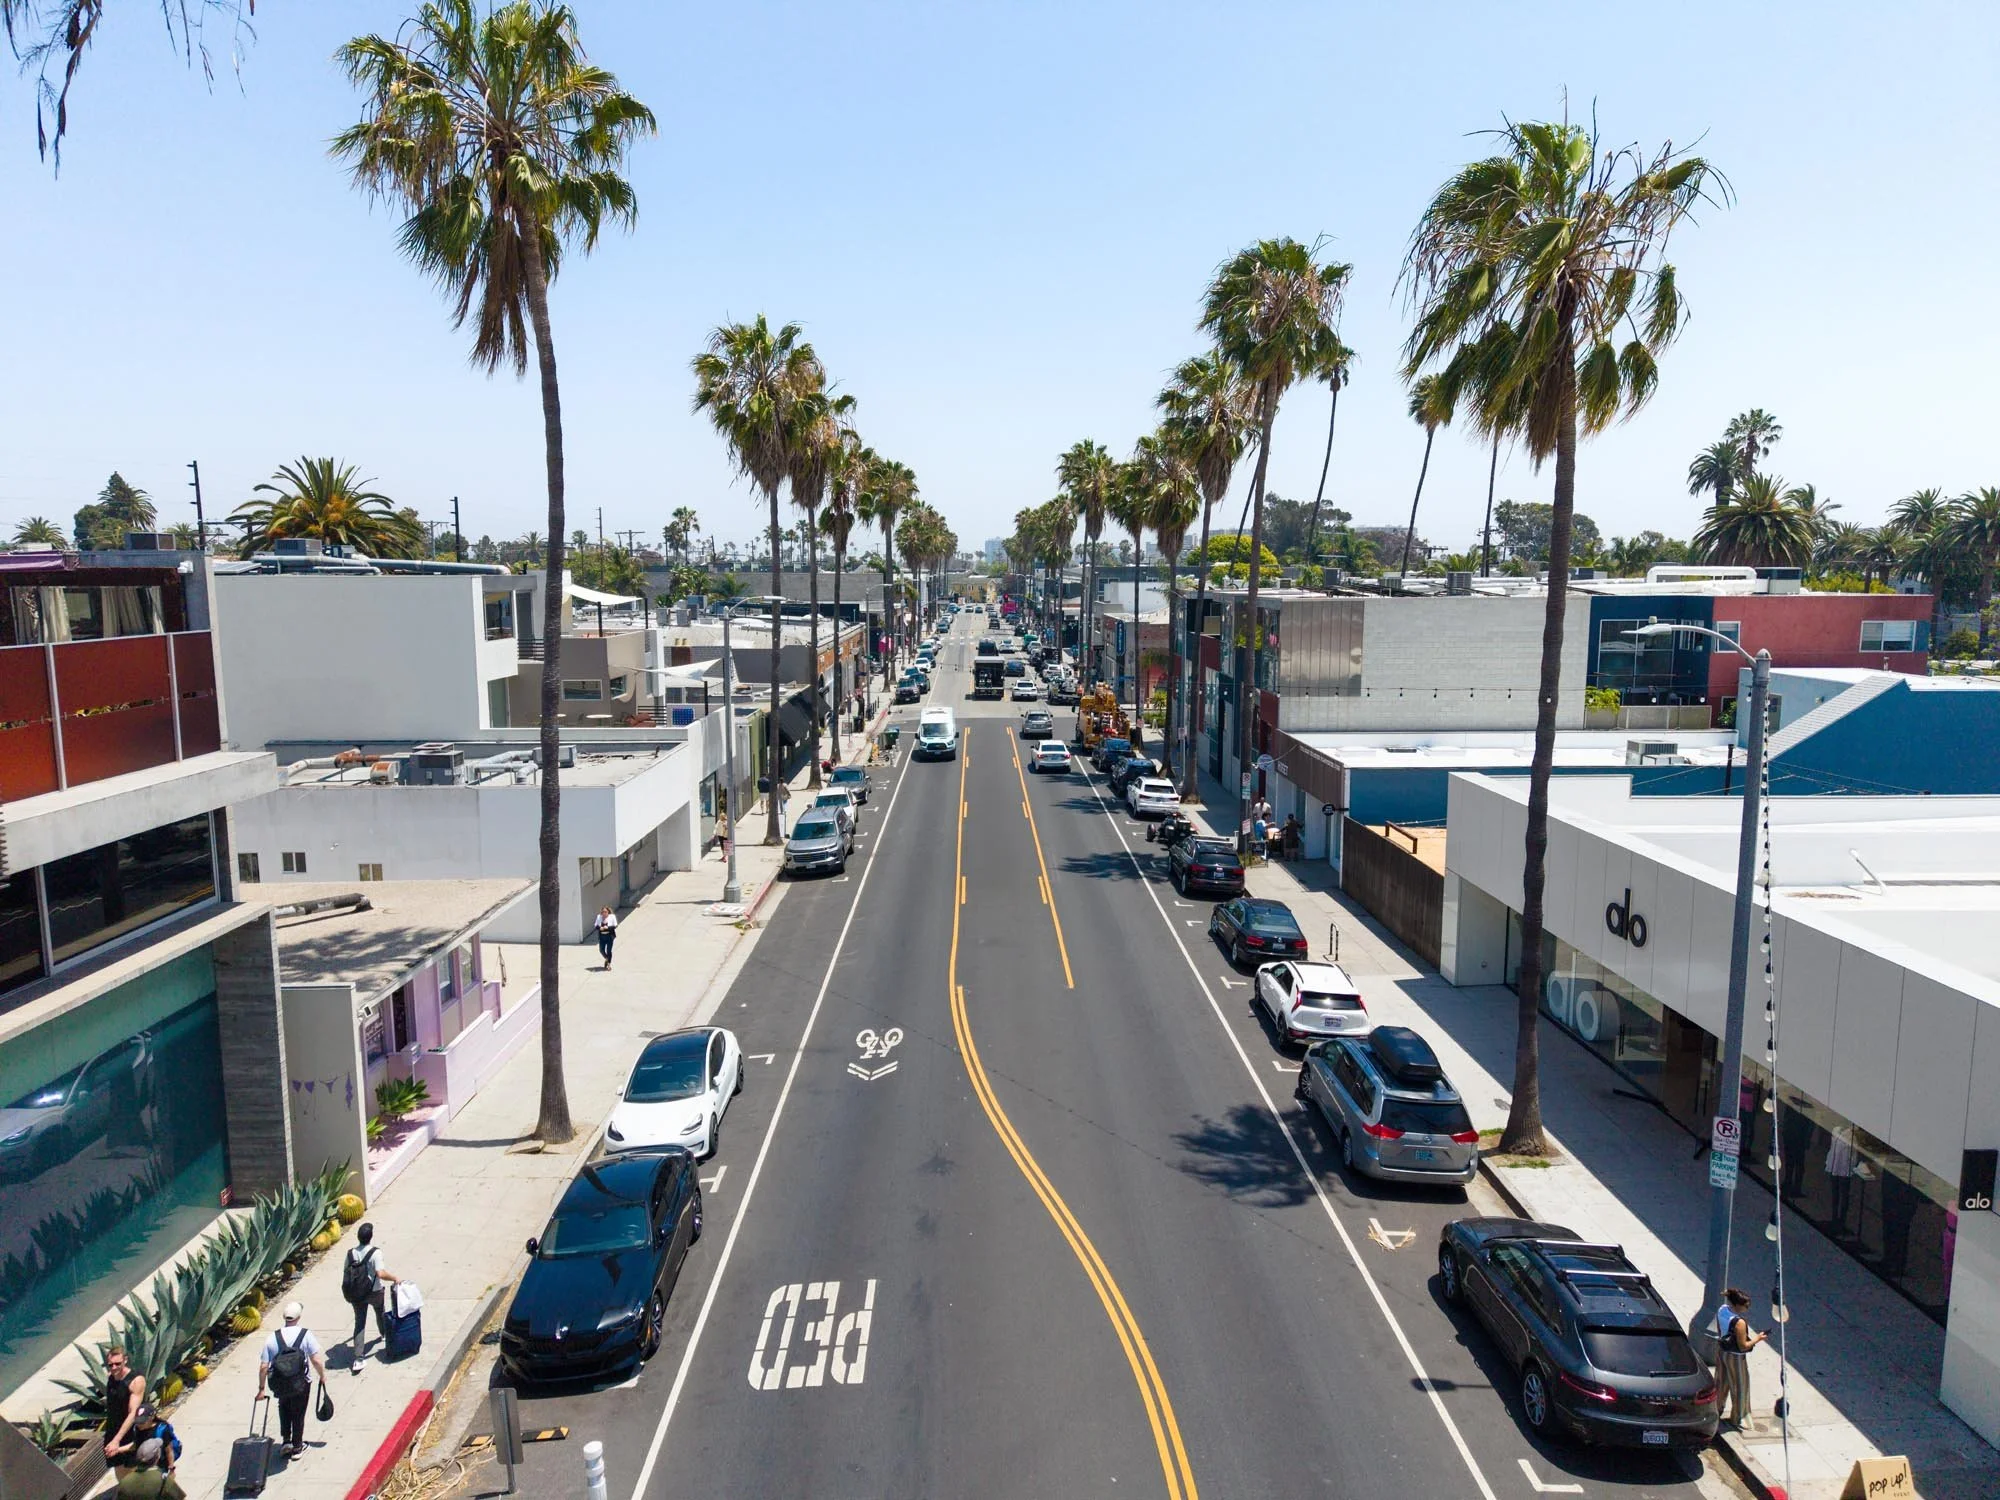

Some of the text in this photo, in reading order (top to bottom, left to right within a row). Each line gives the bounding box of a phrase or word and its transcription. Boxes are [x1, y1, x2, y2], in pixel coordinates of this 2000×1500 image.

[1606, 888, 1647, 948] alo
[1547, 951, 1599, 1041] alo
[1712, 1161, 1736, 1173] PARKING
[1965, 1191, 1990, 1209] alo
[748, 1279, 876, 1390] PED
